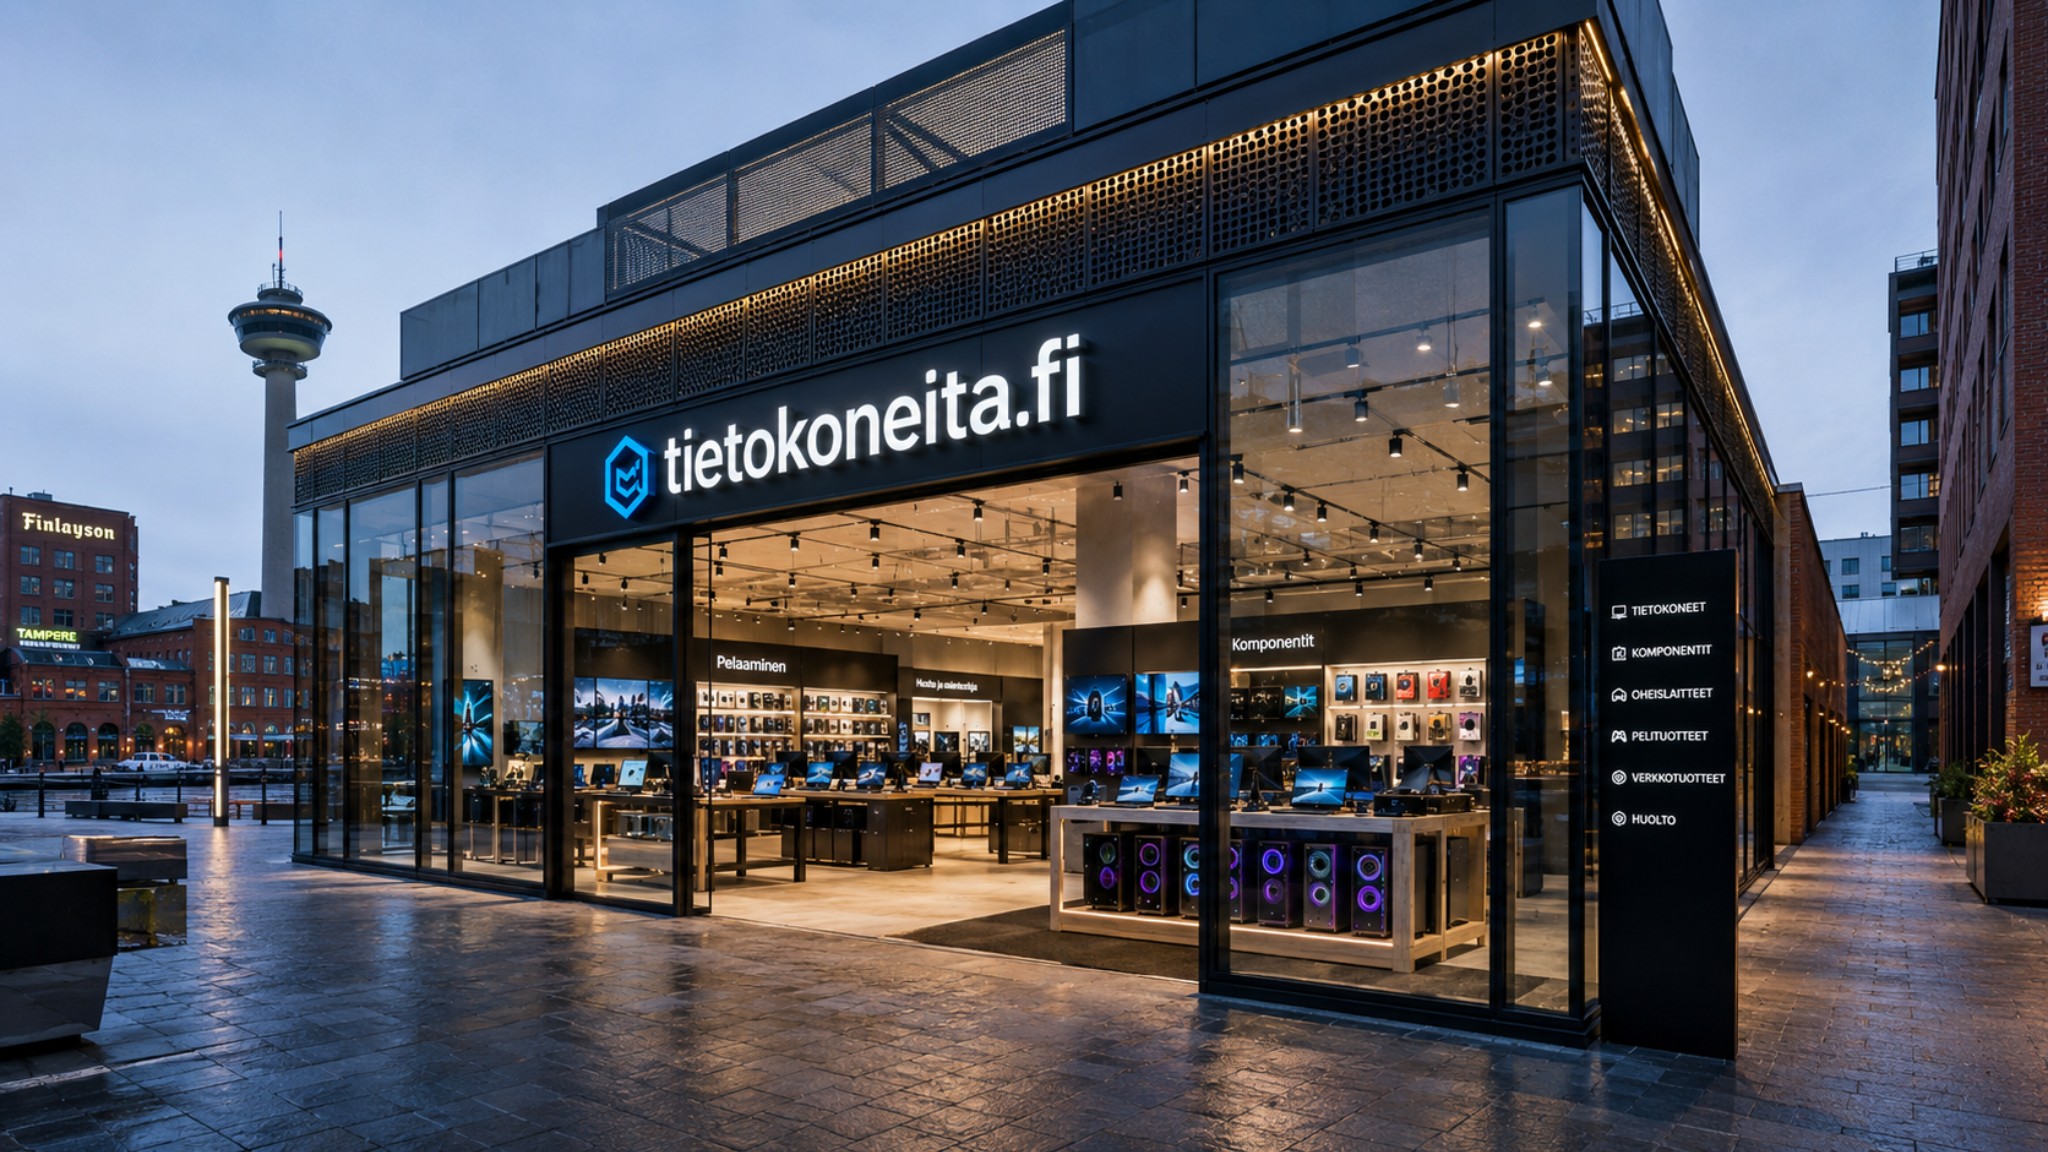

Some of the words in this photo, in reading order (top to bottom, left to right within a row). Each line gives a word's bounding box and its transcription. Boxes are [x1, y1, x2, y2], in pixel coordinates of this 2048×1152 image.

[664, 333, 1082, 495] tietokoneita.fi
[22, 512, 115, 540] Finlayson
[1631, 601, 1707, 616] TIETOKONEET
[16, 628, 77, 642] TAMPERE
[1231, 634, 1315, 652] Komponentit
[1631, 644, 1713, 658] KOMPONENTIT
[716, 655, 787, 673] Pelaaminen
[1631, 688, 1714, 700] OHEISLAITTEET
[1631, 731, 1709, 742] PELITUOTTEET
[1631, 772, 1726, 784] VERKKOTUOTTEET
[1631, 814, 1677, 826] HUOLTO
